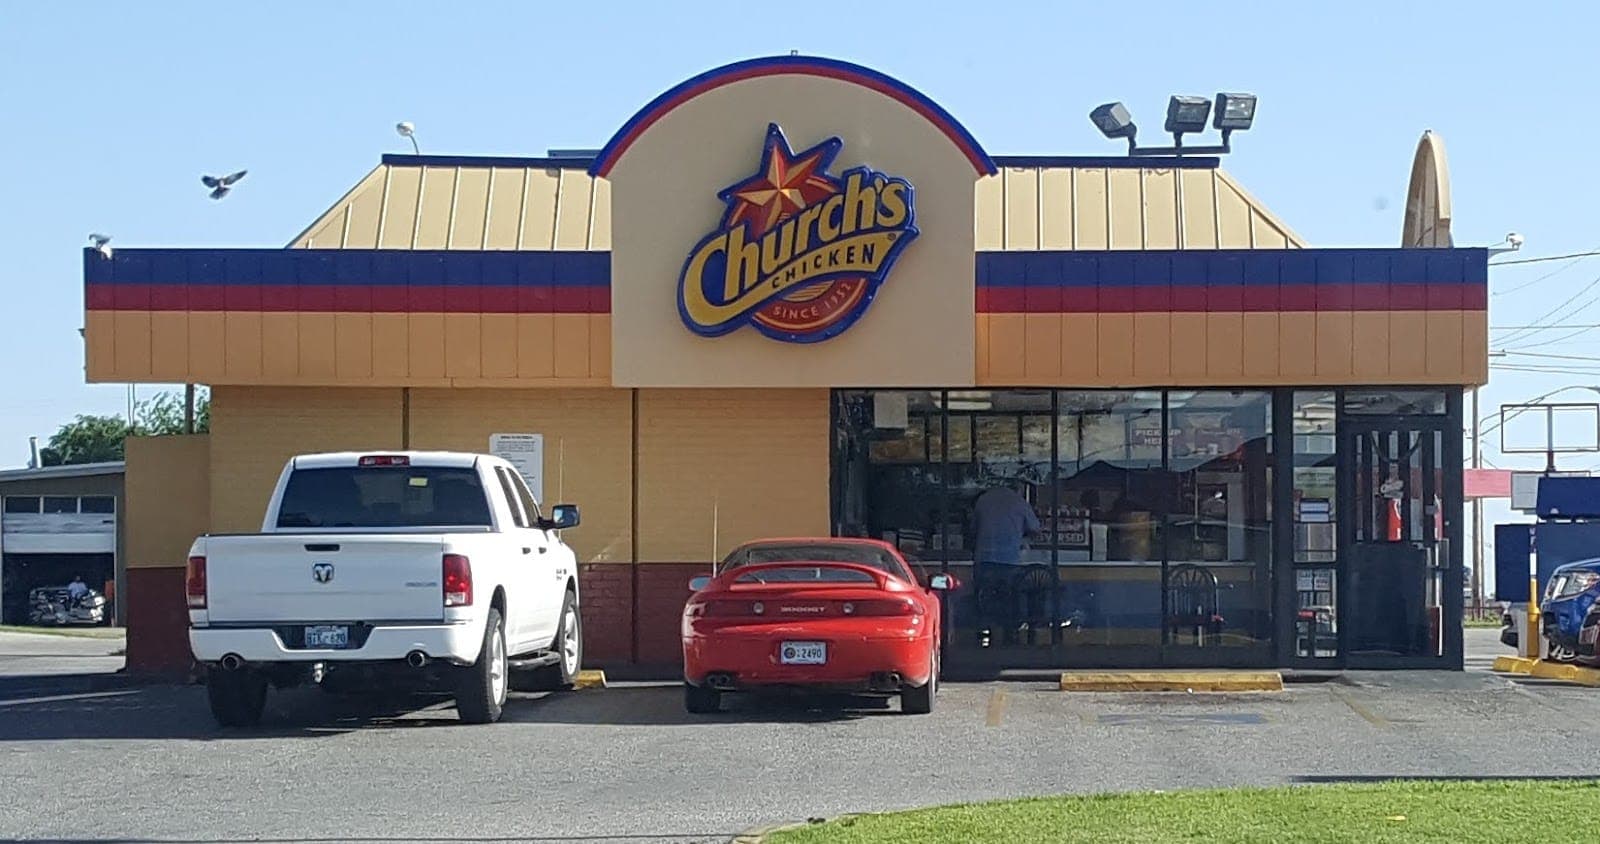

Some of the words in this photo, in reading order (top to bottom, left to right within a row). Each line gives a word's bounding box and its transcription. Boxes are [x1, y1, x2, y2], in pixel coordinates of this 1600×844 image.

[683, 173, 906, 326] Church's
[771, 242, 876, 289] CHICKEN
[773, 304, 819, 319] SINCE
[823, 282, 853, 310] 1952
